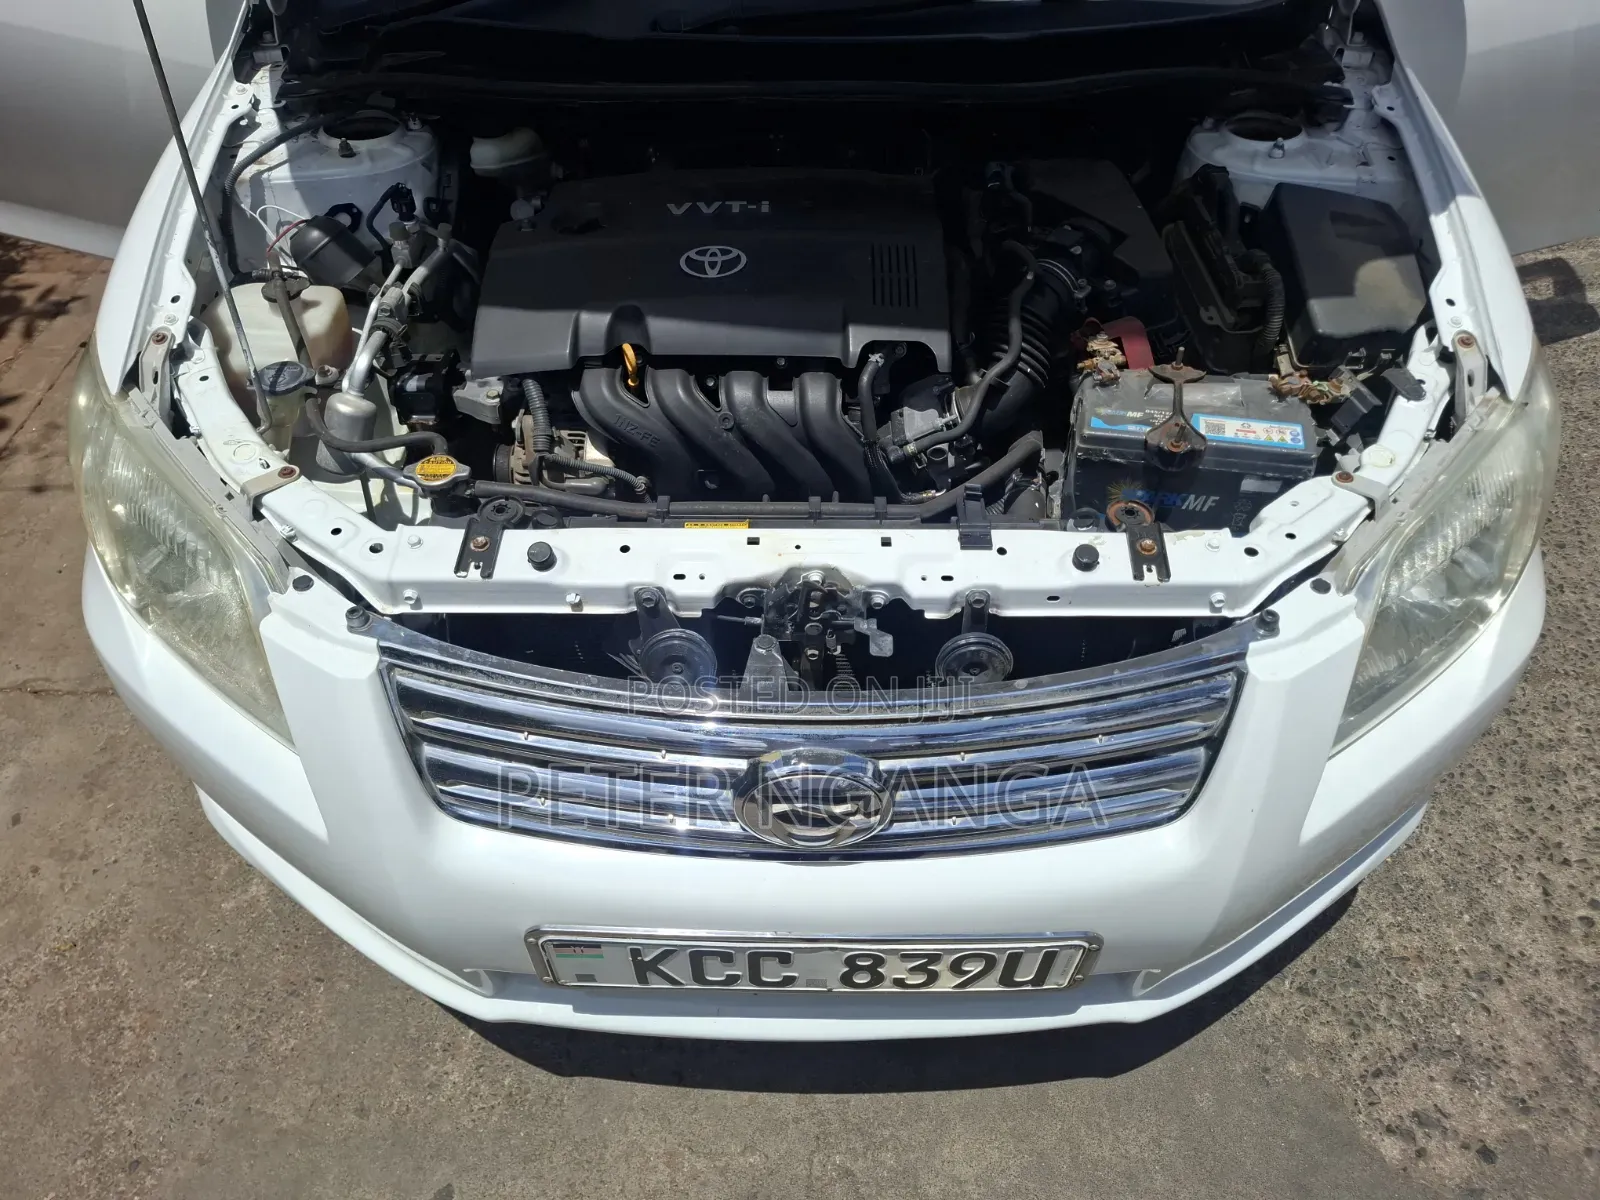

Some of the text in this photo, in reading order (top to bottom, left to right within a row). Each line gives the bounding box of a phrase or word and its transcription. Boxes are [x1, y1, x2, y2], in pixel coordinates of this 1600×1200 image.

[666, 200, 770, 215] VVT-i
[1181, 494, 1220, 512] MF
[627, 946, 800, 988] KCC
[839, 949, 1060, 990] 839U
